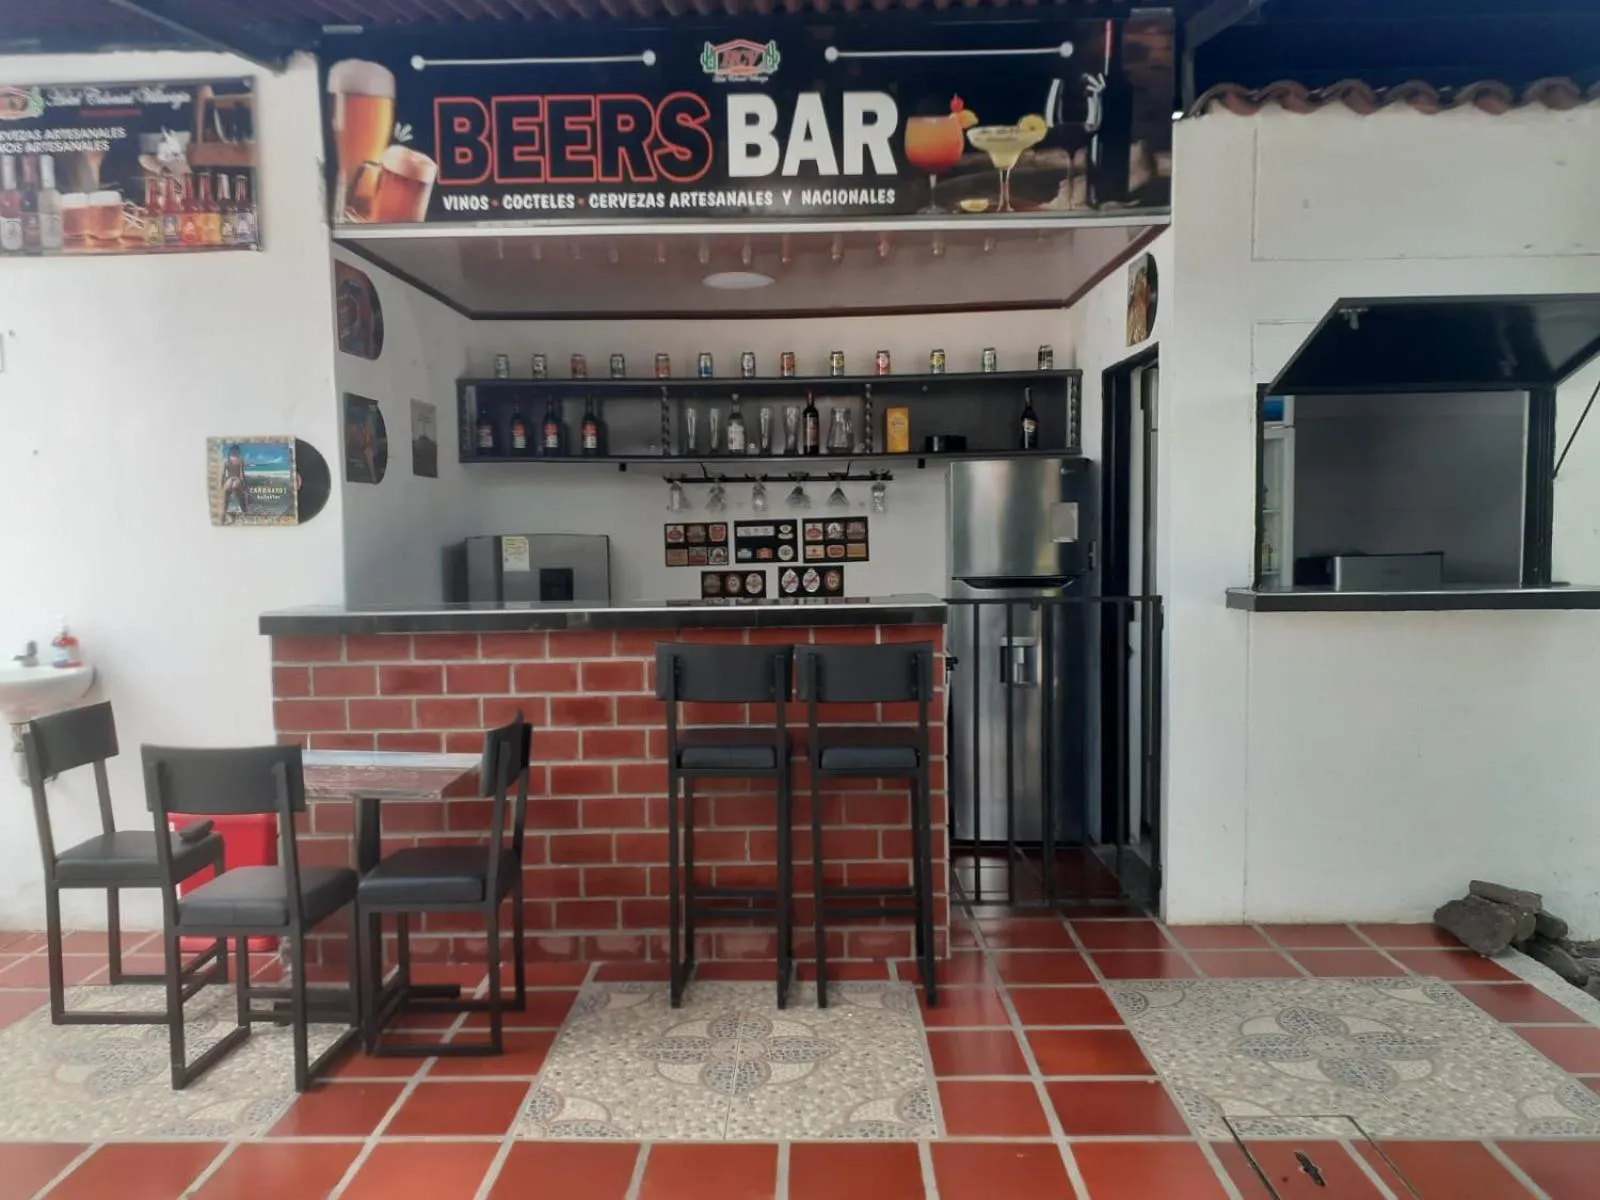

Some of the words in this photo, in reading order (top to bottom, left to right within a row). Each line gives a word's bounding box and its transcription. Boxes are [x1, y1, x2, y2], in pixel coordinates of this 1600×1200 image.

[433, 91, 713, 184] BEERS
[726, 91, 899, 178] BAR
[442, 196, 489, 211] VINOS
[502, 194, 575, 210] COCTELES
[588, 193, 666, 209] CERVEZAS
[669, 191, 773, 208] ARTESANALES
[782, 189, 793, 206] Y
[801, 188, 896, 205] NACIONALES
